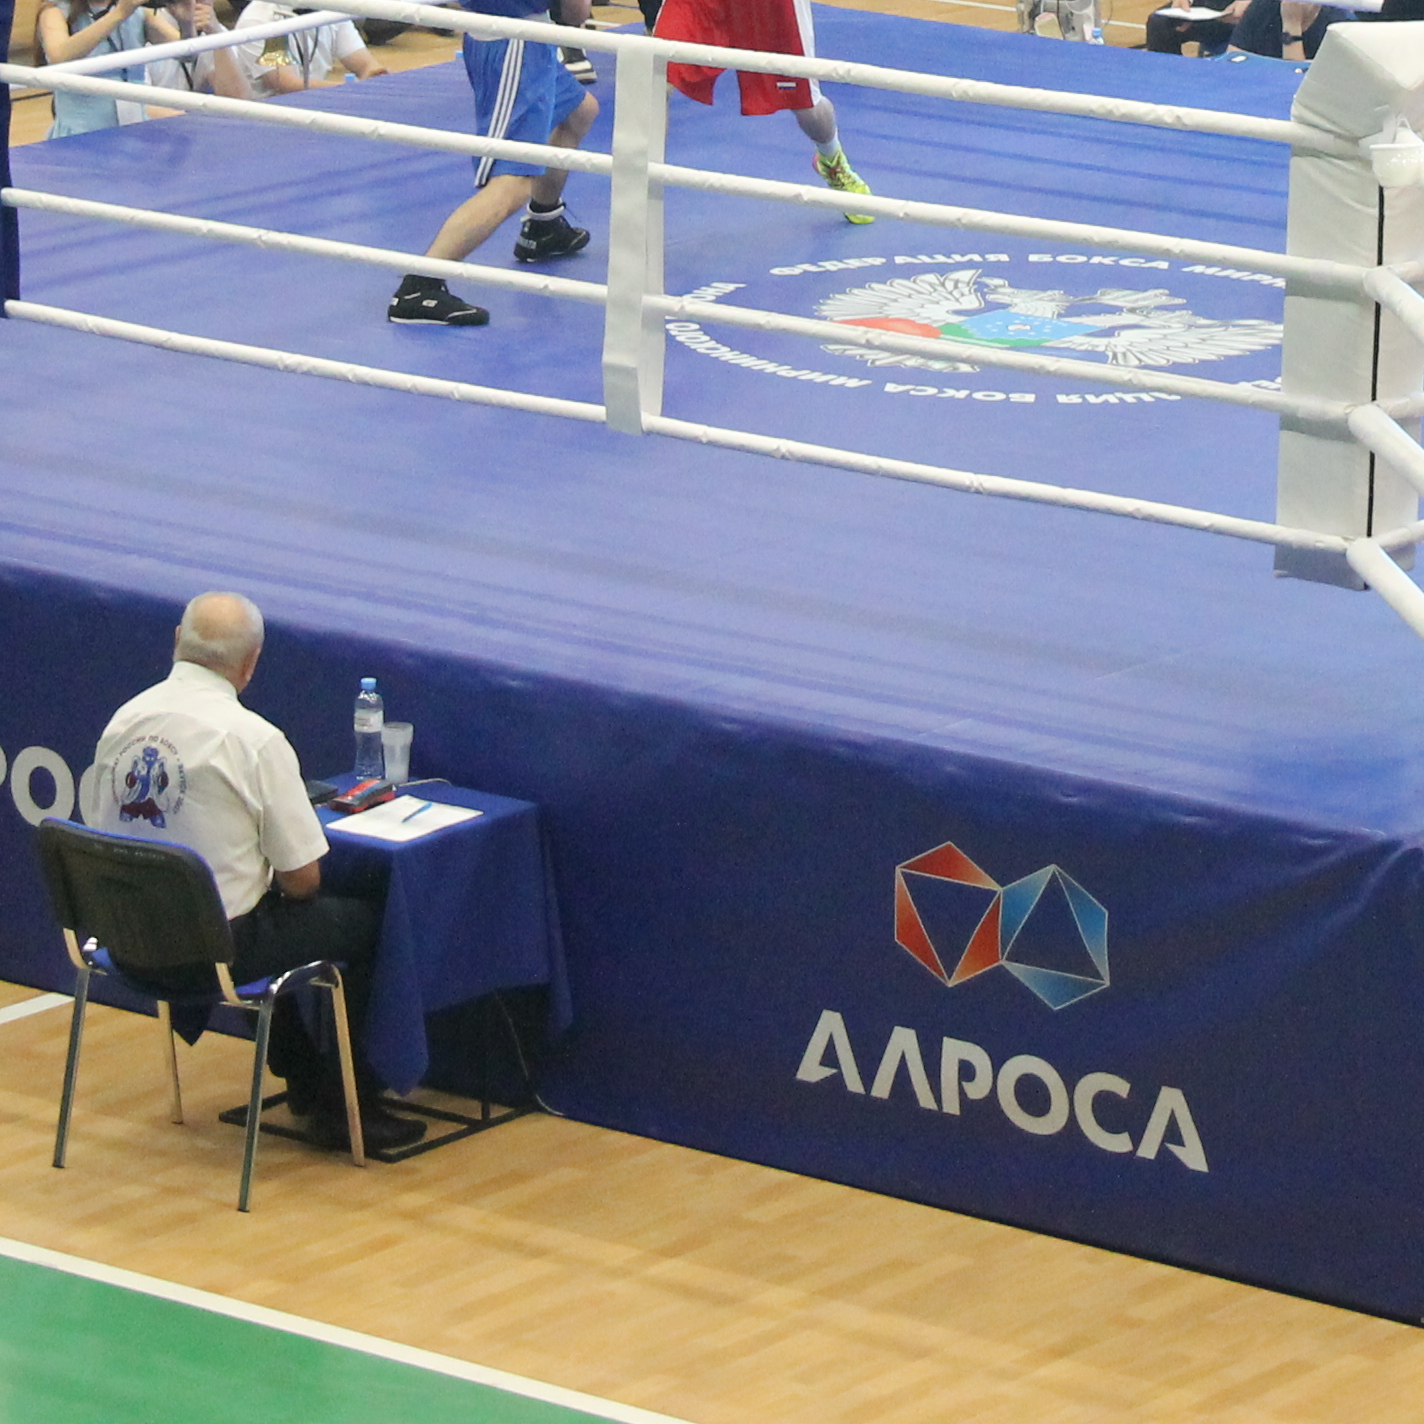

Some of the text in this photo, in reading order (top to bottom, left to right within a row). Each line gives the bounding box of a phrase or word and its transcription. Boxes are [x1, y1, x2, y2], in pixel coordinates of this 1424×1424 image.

[1027, 253, 1170, 270] БОКСА
[884, 381, 1036, 404] БОКСА
[795, 1008, 1209, 1173] АЛРОСА
